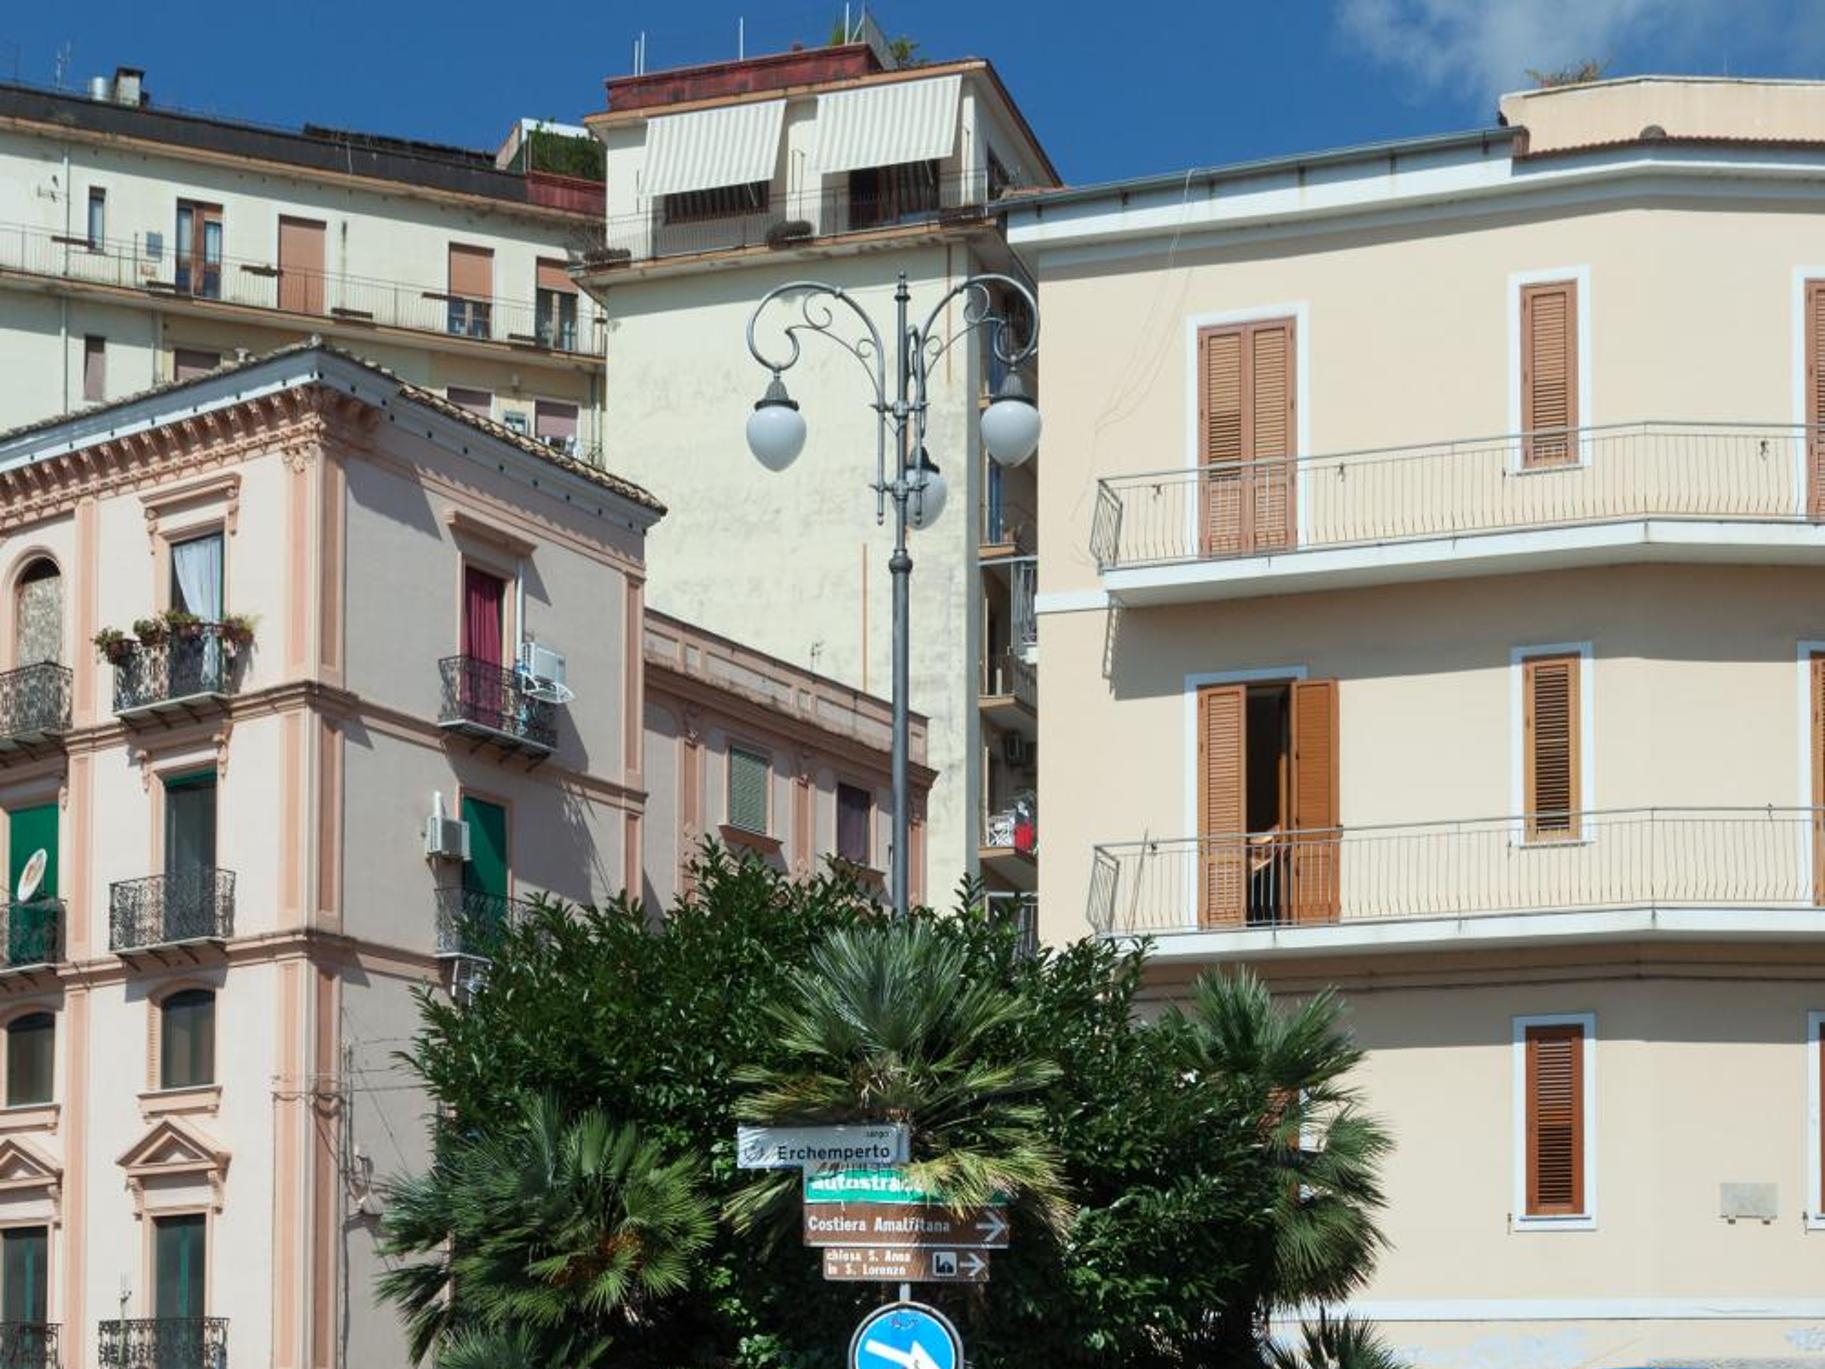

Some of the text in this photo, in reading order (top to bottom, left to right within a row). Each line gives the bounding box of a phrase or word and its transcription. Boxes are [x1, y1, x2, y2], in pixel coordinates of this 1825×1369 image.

[778, 1145, 890, 1160] Erchemperto
[808, 1216, 950, 1232] Costiera Amalfitana
[826, 1250, 911, 1262] chiesa S. Anna
[845, 1264, 857, 1275] S.
[862, 1264, 906, 1275] Lorenzo
